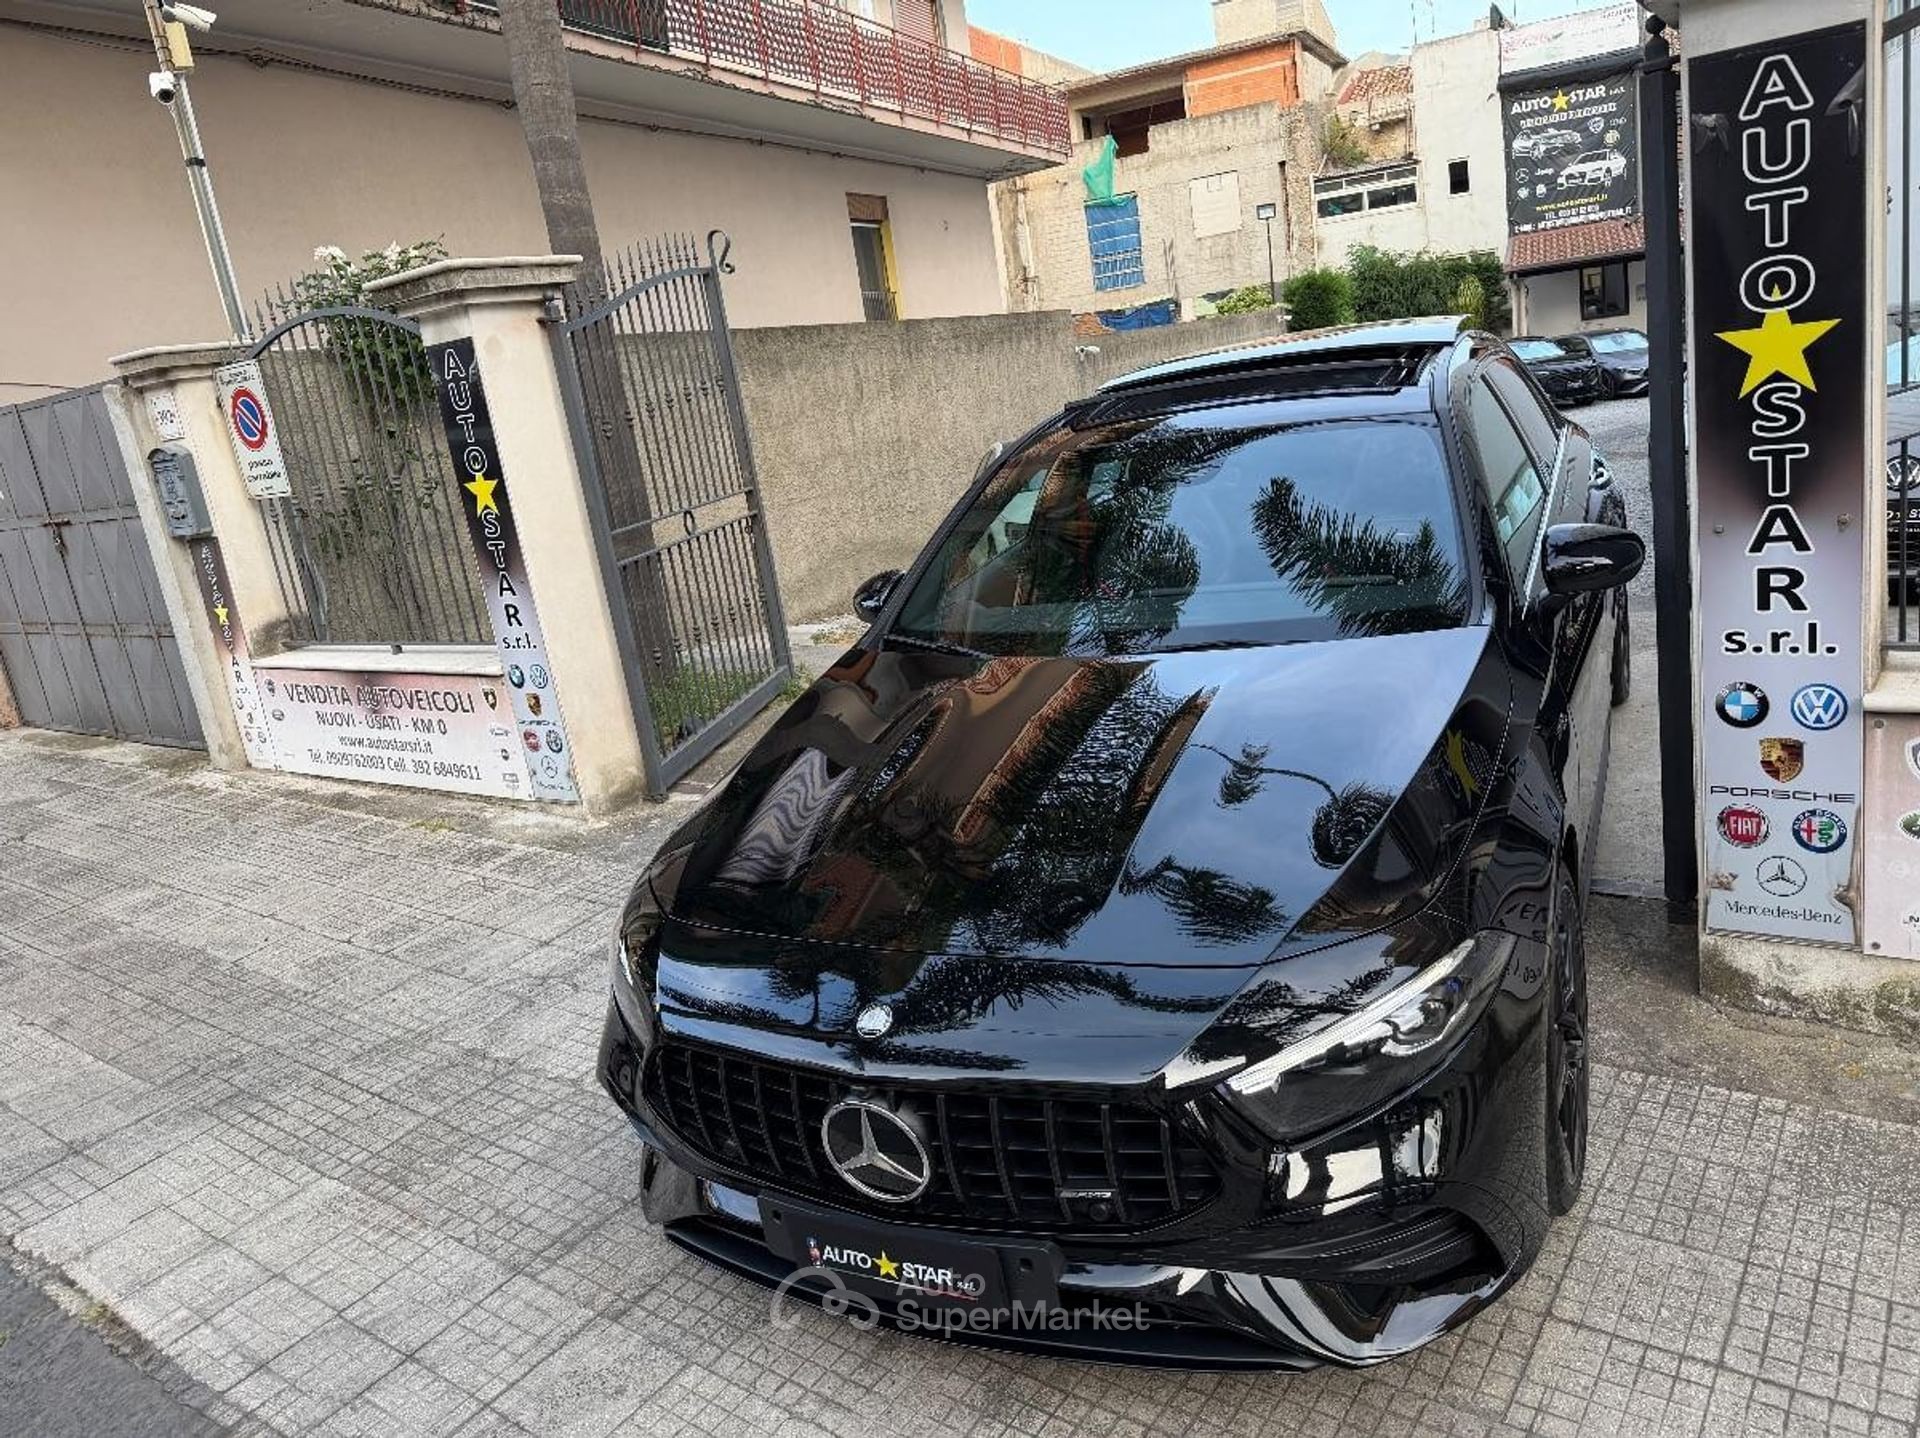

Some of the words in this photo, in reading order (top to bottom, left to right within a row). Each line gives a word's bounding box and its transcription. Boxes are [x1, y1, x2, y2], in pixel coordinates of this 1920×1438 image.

[1511, 96, 1552, 115] AUTO
[1568, 85, 1607, 103] STAR
[1739, 54, 1816, 313] AUTO
[444, 349, 488, 474] AUTO
[1746, 382, 1815, 613] STAR
[482, 509, 524, 627] STAR
[502, 633, 537, 650] s.r.l.
[1723, 620, 1838, 655] s.r.l.
[283, 683, 352, 706] VENDITA
[356, 684, 475, 713] AUTOVEICOLI
[315, 711, 356, 728] NUOVI
[365, 714, 400, 731] USATI
[411, 717, 435, 734] KM
[411, 758, 431, 775] 392
[433, 761, 482, 780] 6849611
[1710, 786, 1856, 804] PORSCHE
[1729, 816, 1759, 836] FIAT
[1725, 900, 1843, 925] Mercedes-Benz
[822, 1245, 873, 1269] AUTO
[902, 1262, 953, 1286] STAR
